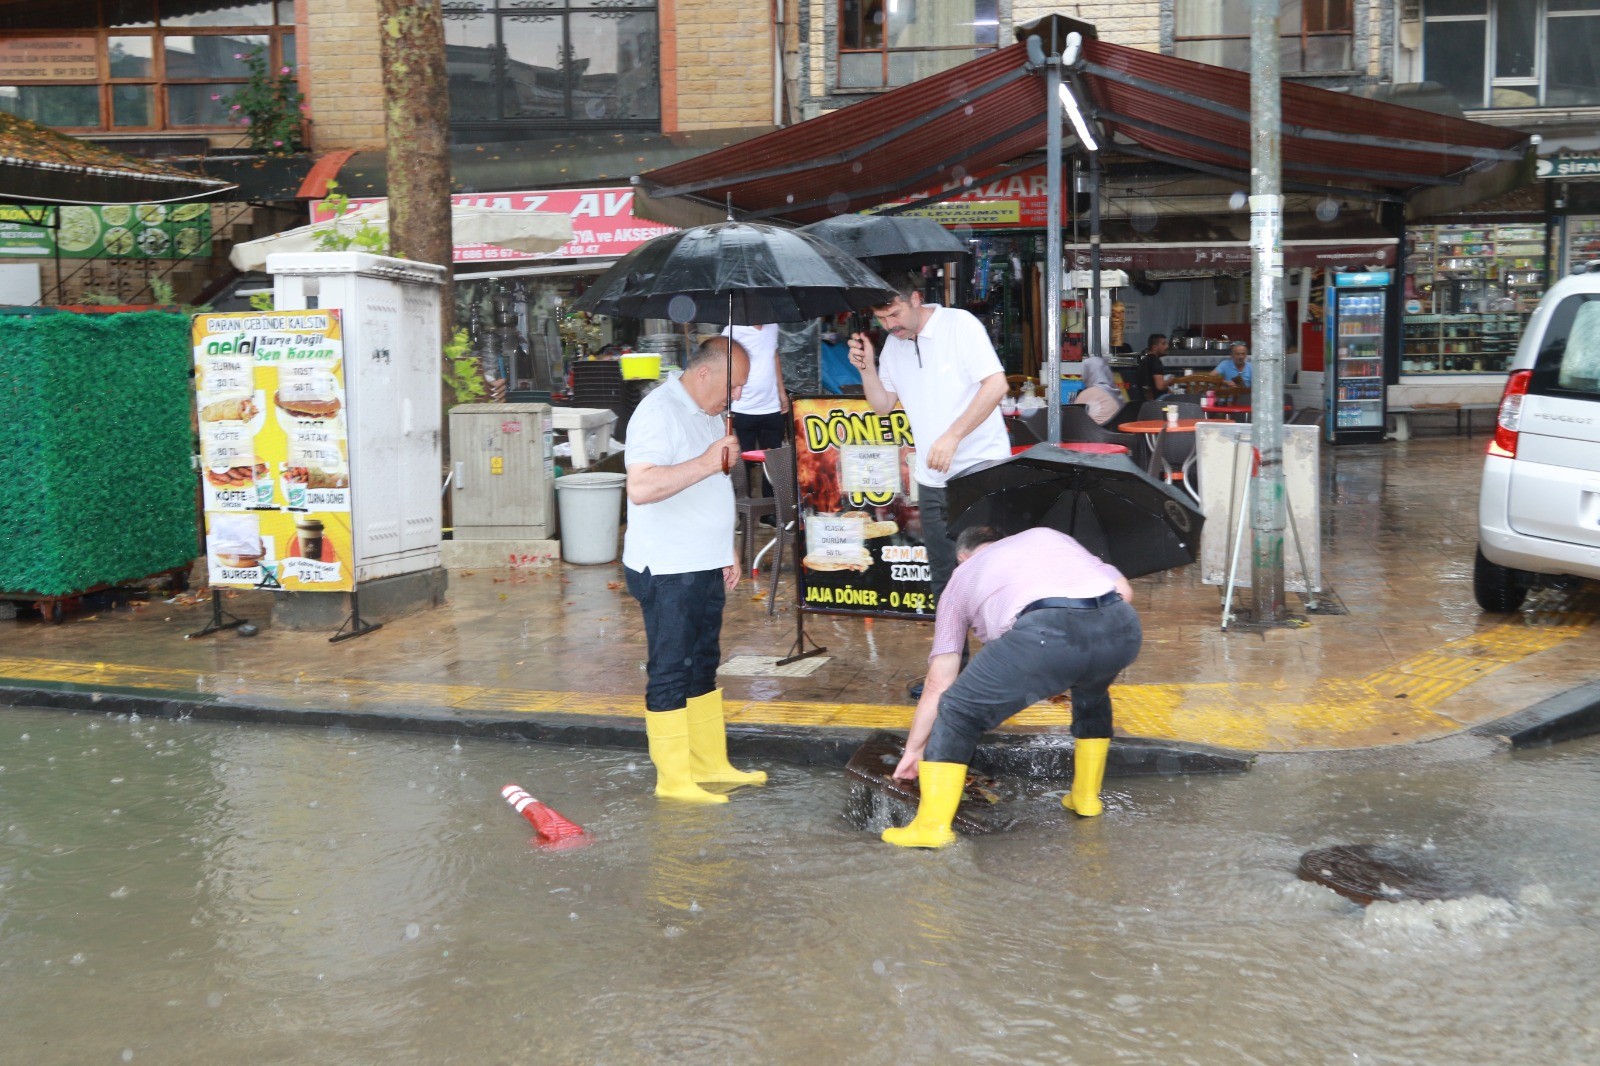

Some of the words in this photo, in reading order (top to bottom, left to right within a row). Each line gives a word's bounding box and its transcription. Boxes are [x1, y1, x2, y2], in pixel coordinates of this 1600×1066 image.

[1557, 161, 1600, 175] ŞİFA
[208, 319, 241, 332] PARAN
[243, 316, 285, 331] CEBİNDE
[288, 316, 326, 330] KALSIN
[255, 348, 280, 361] Sen
[287, 347, 334, 360] Kazan
[213, 430, 240, 441] KÖFTE
[805, 409, 915, 451] DÖNER
[215, 488, 247, 501] KÖFTE
[884, 548, 909, 560] ZAM
[222, 569, 258, 580] BURGER
[893, 567, 919, 579] ZAM
[805, 586, 833, 603] JAJA
[835, 584, 878, 606] DÖNER
[902, 592, 927, 609] 452
